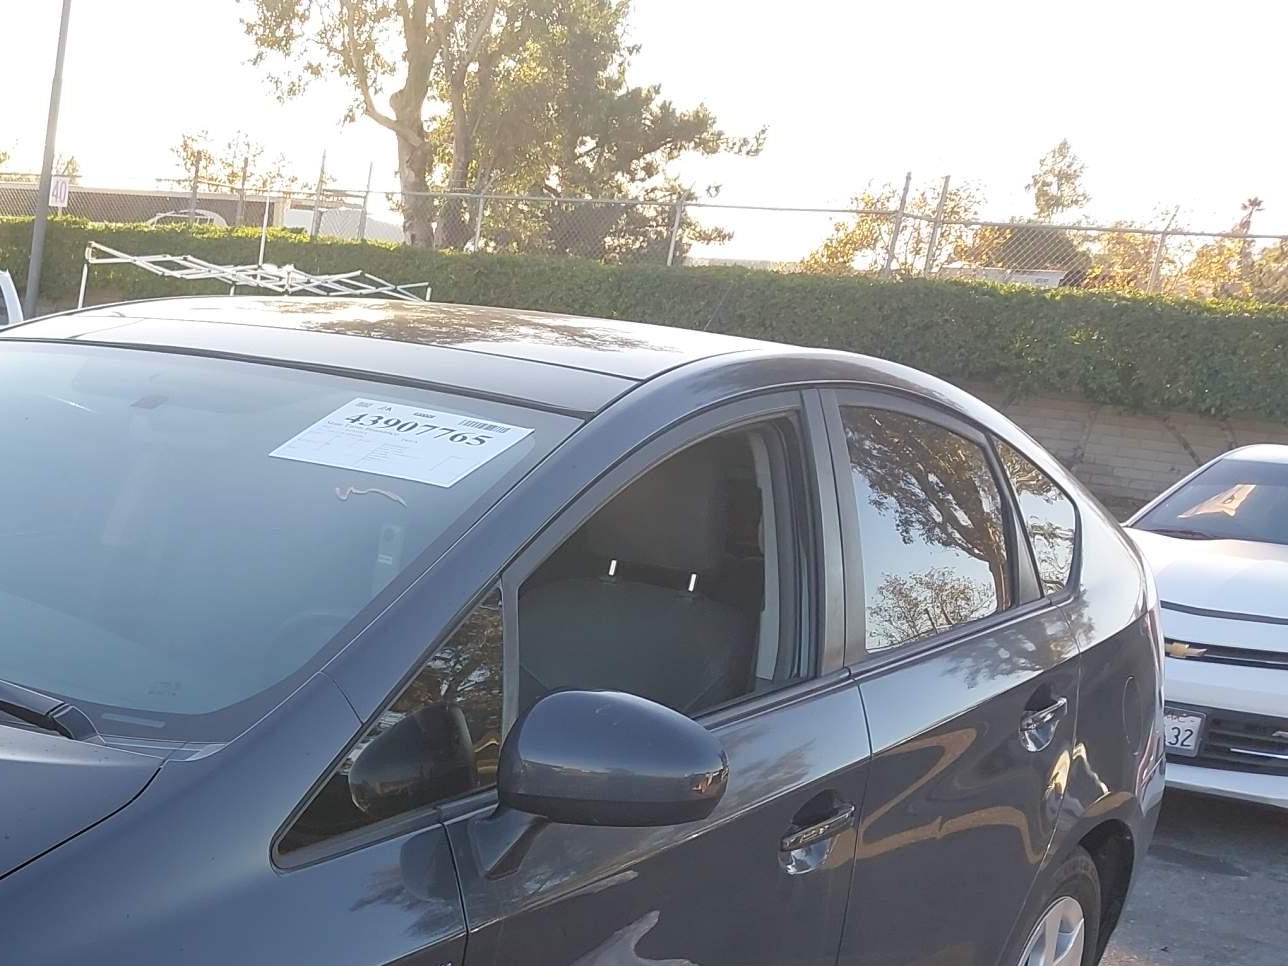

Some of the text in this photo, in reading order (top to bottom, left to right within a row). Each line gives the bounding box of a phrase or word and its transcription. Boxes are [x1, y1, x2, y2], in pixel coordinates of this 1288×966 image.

[51, 180, 67, 203] 40
[345, 413, 494, 446] 43907765
[1164, 726, 1194, 747] 32
